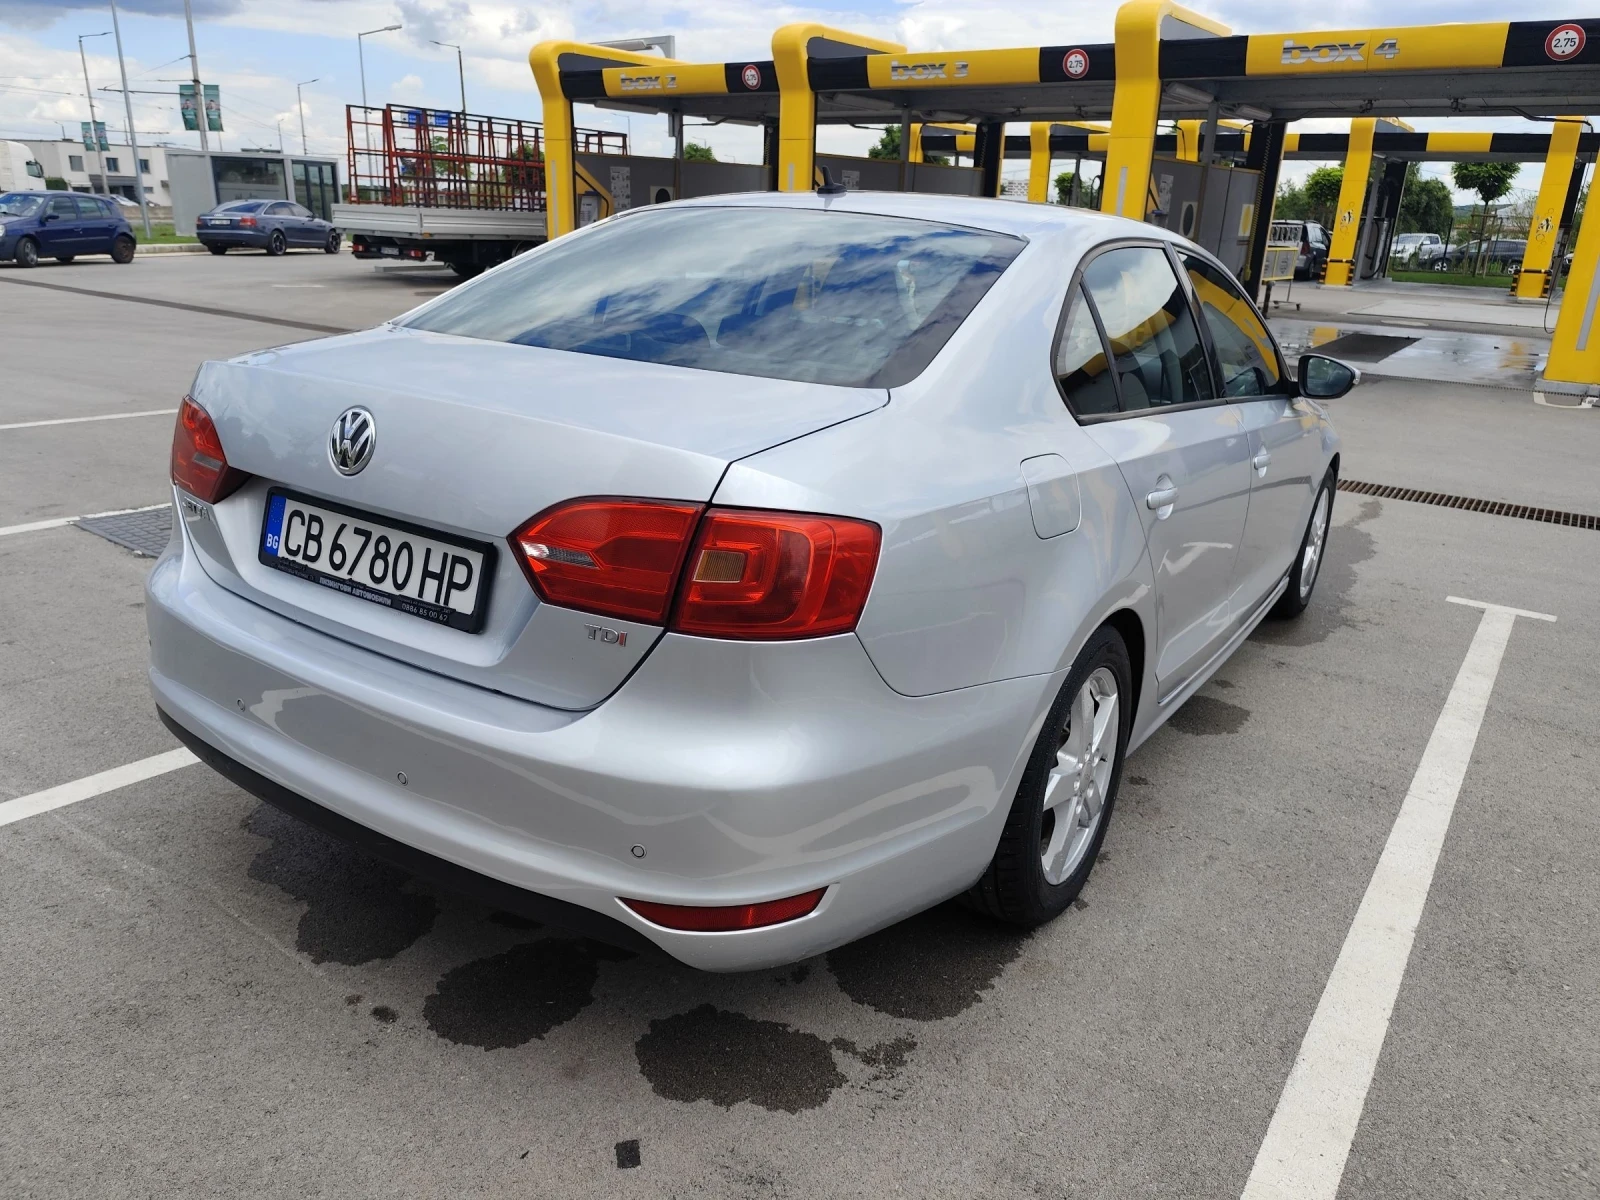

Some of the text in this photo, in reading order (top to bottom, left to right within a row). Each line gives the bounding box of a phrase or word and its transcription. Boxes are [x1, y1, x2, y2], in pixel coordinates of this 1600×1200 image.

[1281, 38, 1401, 65] box 4
[1553, 37, 1577, 49] 2.75
[890, 60, 969, 81] box 3
[1068, 59, 1084, 69] 2.75
[620, 73, 677, 91] box 2
[266, 533, 279, 549] BG
[284, 509, 474, 607] CB 6780 HP
[401, 603, 418, 614] 0886
[584, 623, 628, 647] TDI
